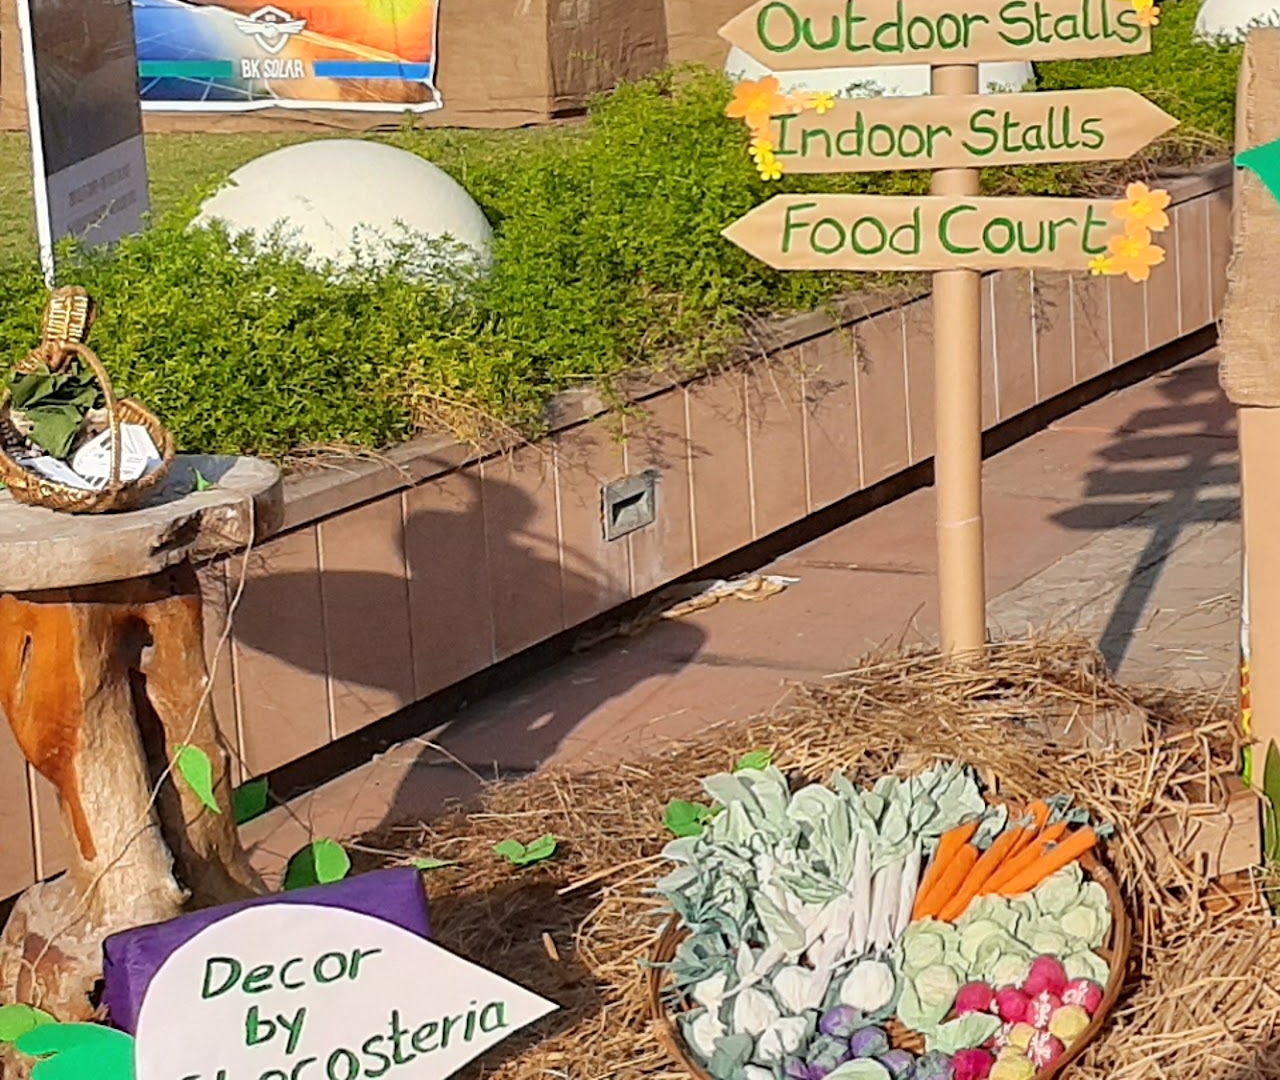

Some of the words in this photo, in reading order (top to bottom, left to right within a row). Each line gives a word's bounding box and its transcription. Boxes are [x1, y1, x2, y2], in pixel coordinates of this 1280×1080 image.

[756, 0, 989, 53] Outdoor
[241, 58, 261, 79] BK
[263, 58, 305, 79] SOLAR
[771, 110, 952, 158] Indoor
[961, 106, 1104, 156] Stalls
[781, 201, 921, 255] Food
[937, 204, 1108, 255] Court
[200, 943, 382, 1001] Decor
[243, 1005, 307, 1056] by
